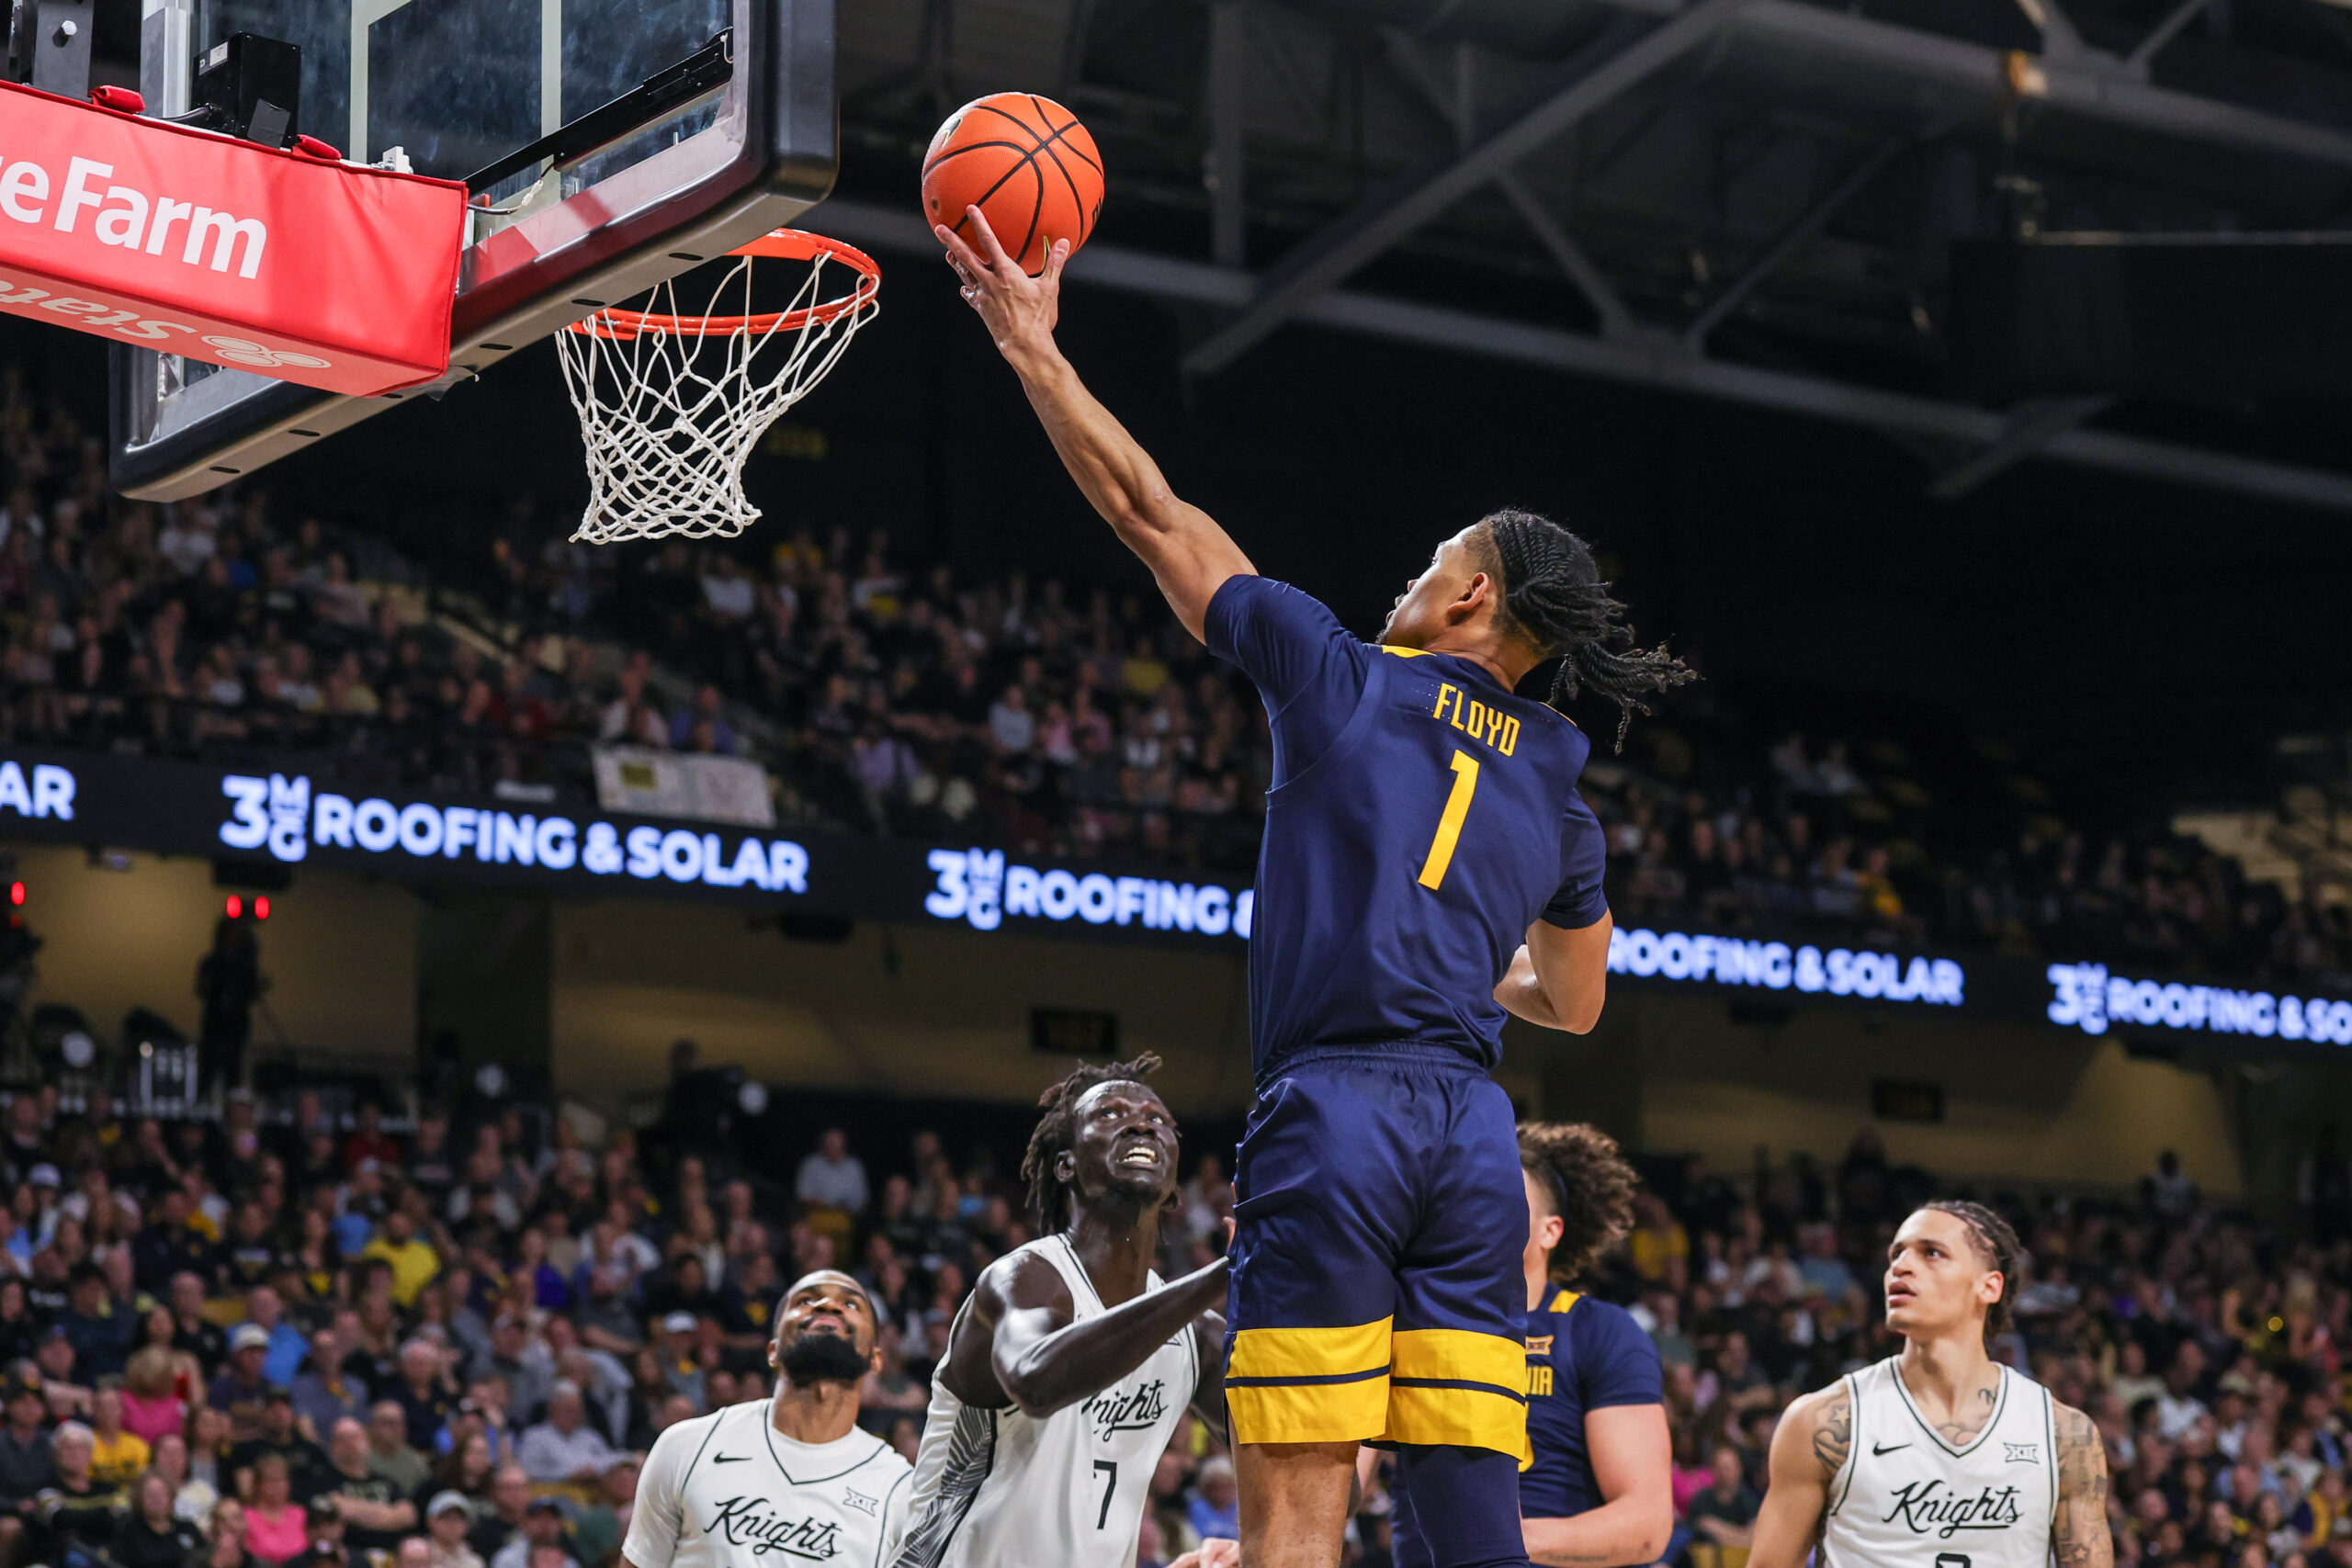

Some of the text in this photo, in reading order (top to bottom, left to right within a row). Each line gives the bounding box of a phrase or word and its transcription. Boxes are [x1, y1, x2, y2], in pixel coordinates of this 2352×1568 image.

[1432, 682, 1521, 757] FLOYD
[313, 793, 576, 869] ROOFING
[626, 826, 808, 893] SOLAR
[1417, 749, 1480, 891] 1
[1004, 865, 1229, 936] ROOFING
[1826, 948, 1963, 1007] SOLAR
[2108, 976, 2277, 1037] ROOFING
[1080, 1380, 1169, 1442] nights
[703, 1495, 843, 1562] Knights
[1093, 1460, 1117, 1530] 7
[1882, 1480, 2025, 1539] Knights
